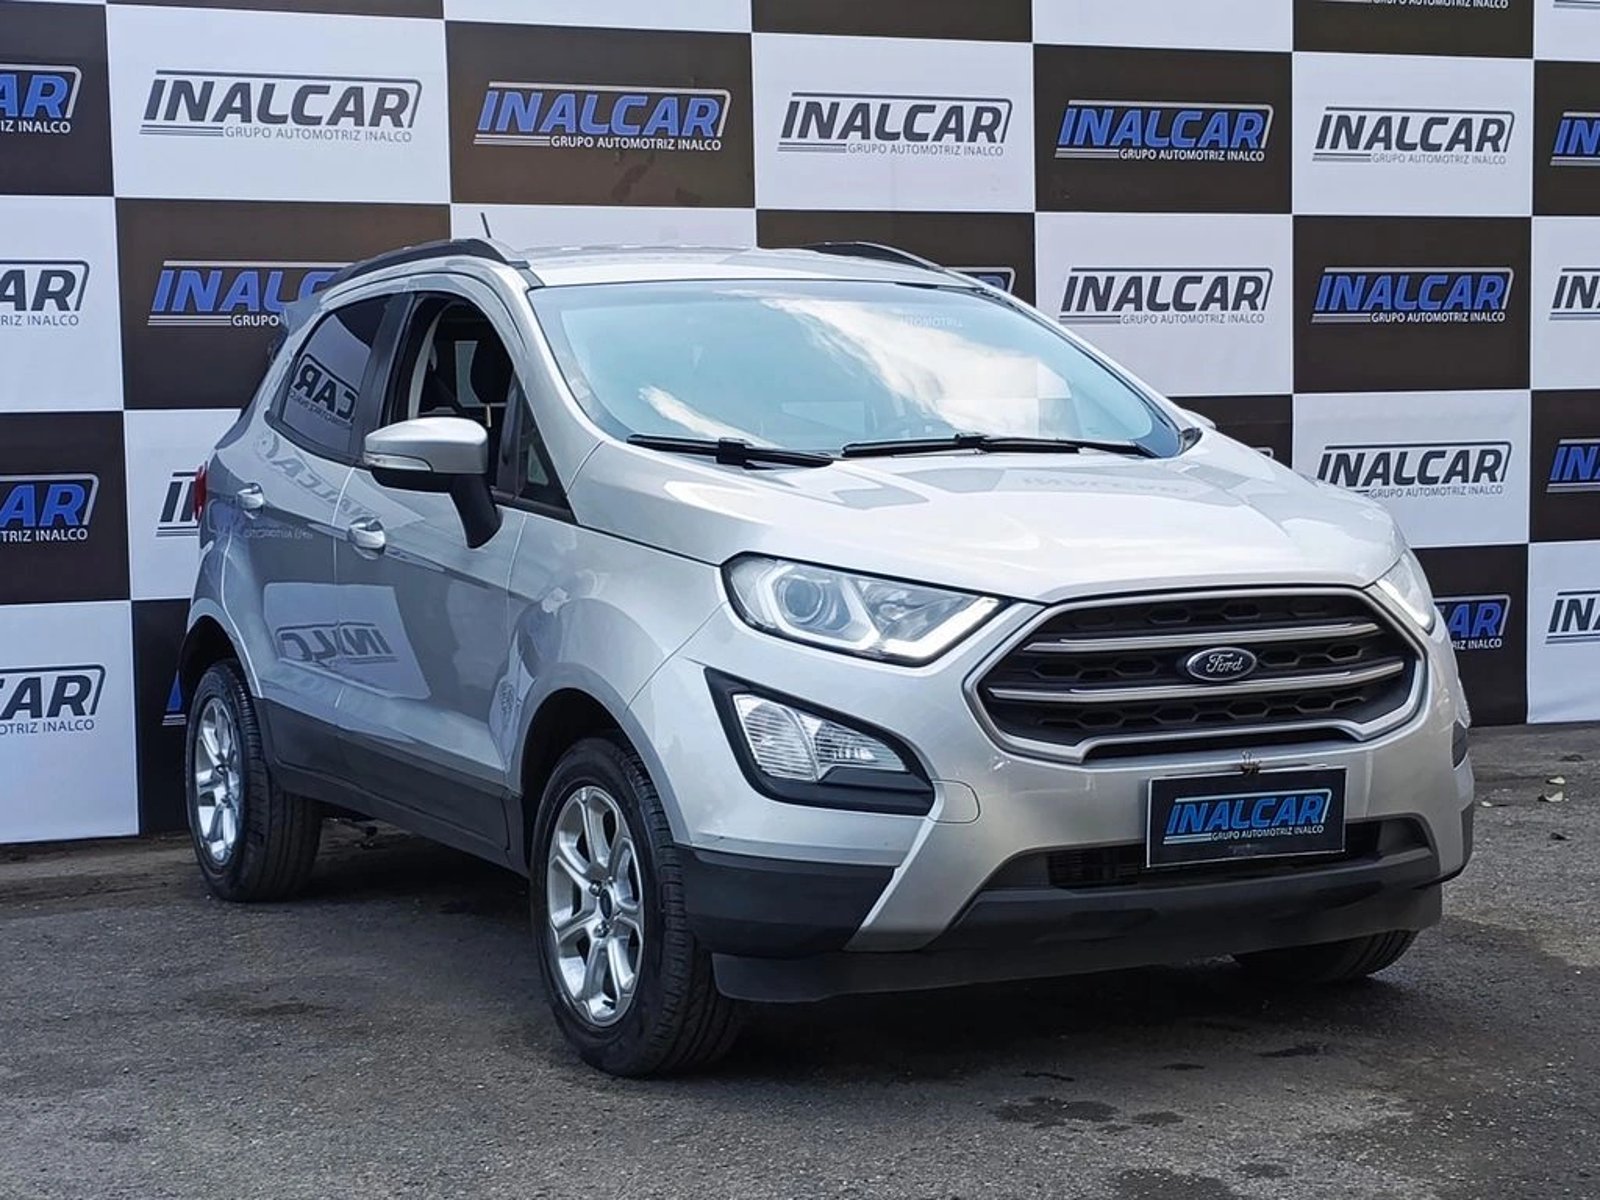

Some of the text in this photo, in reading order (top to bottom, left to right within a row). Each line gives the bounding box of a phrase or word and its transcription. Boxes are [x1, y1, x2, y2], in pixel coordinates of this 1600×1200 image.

[143, 79, 412, 128] INALCAR
[477, 90, 721, 138] INALCAR
[781, 101, 1003, 143] INALCAR
[18, 121, 71, 133] INALCO
[225, 126, 412, 143] GRUPO AUTOMOTRIZ INALCO
[1059, 108, 1265, 149] INALCAR
[1315, 114, 1506, 153] INALCAR
[1553, 119, 1600, 155] IN
[551, 136, 722, 151] GRUPO AUTOMOTRIZ INALCO
[848, 143, 1004, 157] GRUPO AUTOMOTRIZ INALCO
[1120, 149, 1265, 162] GRUPO AUTOMOTRIZ INALCO
[1372, 154, 1507, 165] GRUPO AUTOMOTRIZ INALCO
[1061, 275, 1265, 312] INALCAR
[1314, 273, 1505, 311] INALCAR
[1552, 275, 1600, 309] IN
[28, 315, 79, 326] INALCO
[232, 315, 279, 327] GRUPO
[1121, 313, 1265, 324] GRUPO AUTOMOTRIZ INALCO
[1371, 311, 1505, 323] GRUPO AUTOMOTRIZ INALCO
[1316, 449, 1503, 487] INALCAR
[1549, 446, 1600, 481] IN
[1370, 485, 1503, 499] GRUPO AUTOMOTRIZ INALCO
[36, 528, 88, 541] INALCO
[1437, 602, 1502, 638] AR
[1548, 598, 1600, 633] IN
[1468, 638, 1502, 649] INALCO
[1205, 653, 1244, 673] Ford
[0, 675, 91, 720] AR
[43, 719, 94, 732] INALCO
[1166, 795, 1325, 834] INALCAR
[1212, 824, 1324, 841] GRUPO AUTOMOTRIZ INALCO
